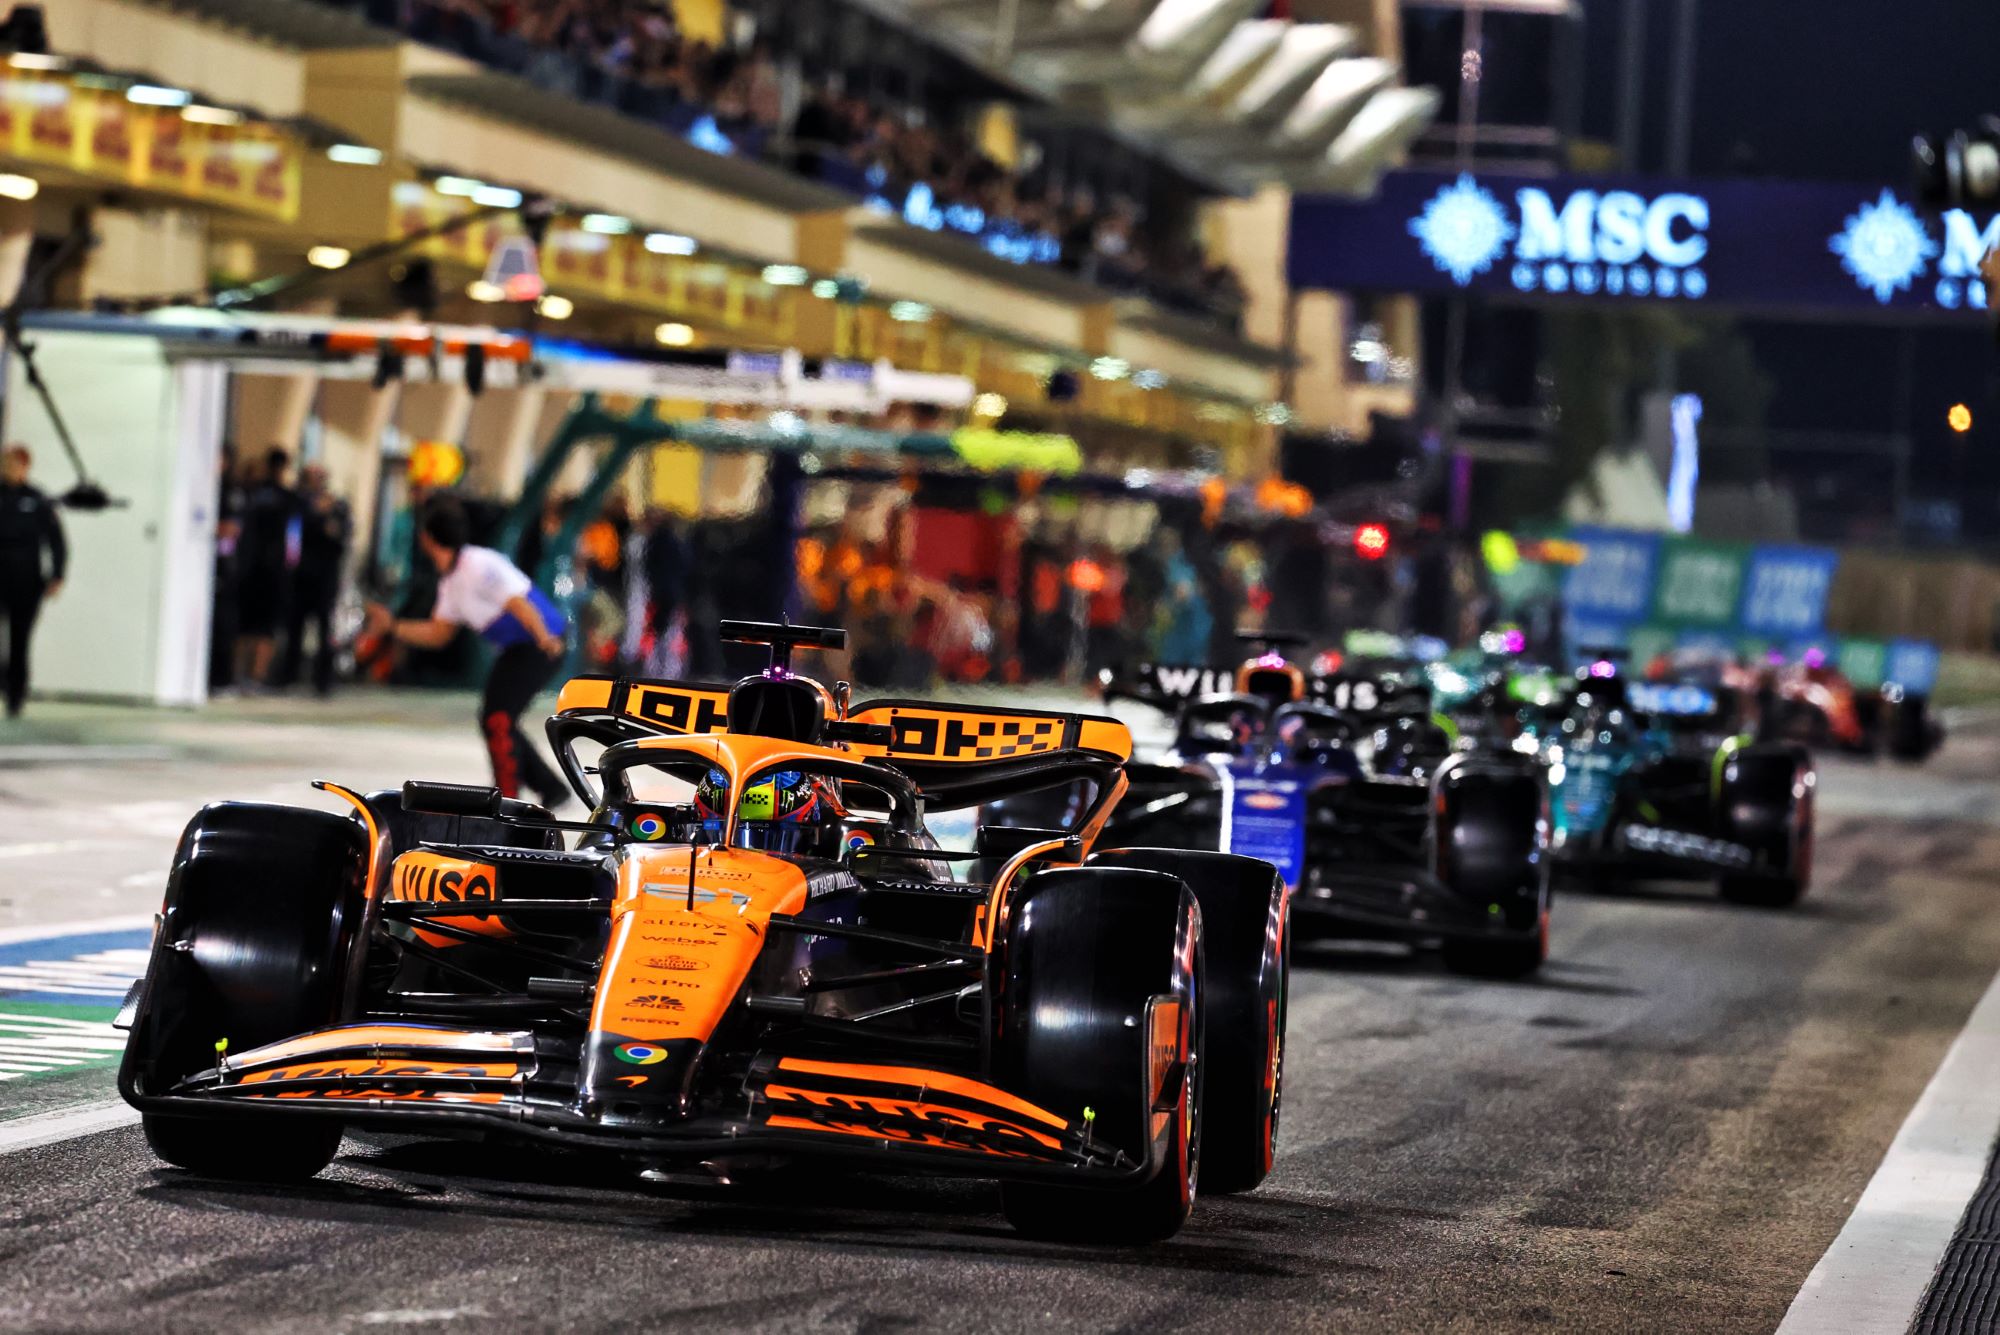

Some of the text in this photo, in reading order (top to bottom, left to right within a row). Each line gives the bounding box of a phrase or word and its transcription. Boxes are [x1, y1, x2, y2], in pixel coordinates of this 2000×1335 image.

[1514, 186, 1709, 267] MSC
[483, 849, 583, 863] vmware
[402, 862, 491, 921] vuse
[811, 870, 857, 899] RICHARD MILLE
[877, 880, 983, 894] vmware
[643, 919, 728, 930] alteryx
[642, 935, 719, 946] webex
[625, 1002, 686, 1012] CNBC
